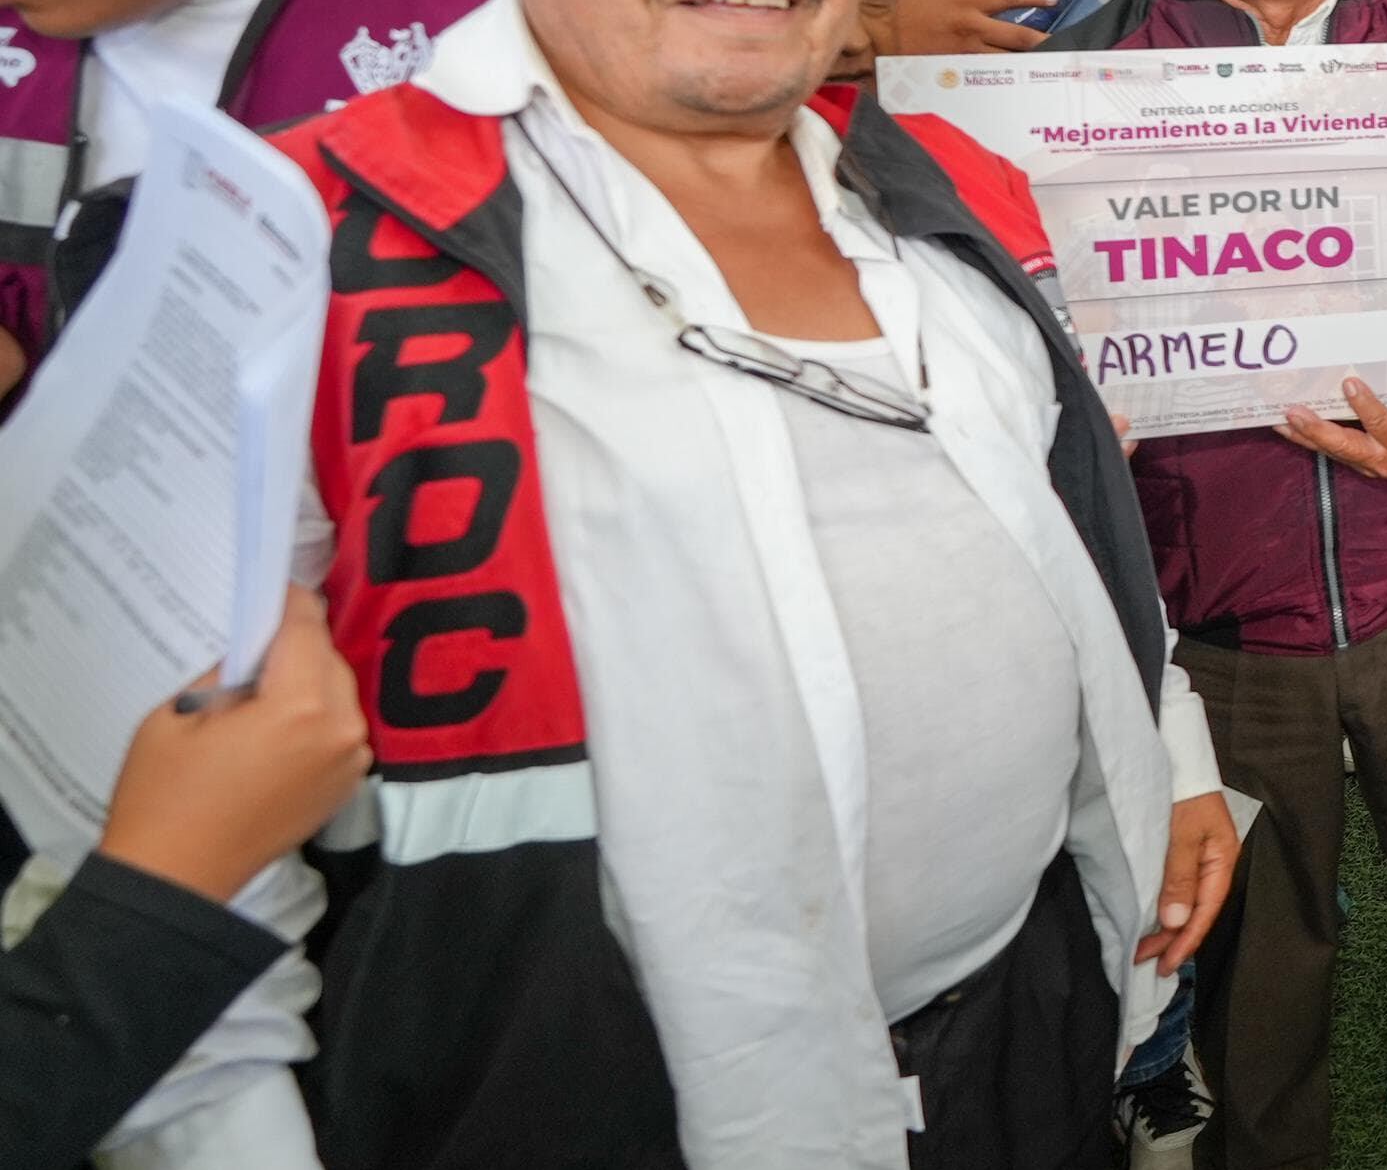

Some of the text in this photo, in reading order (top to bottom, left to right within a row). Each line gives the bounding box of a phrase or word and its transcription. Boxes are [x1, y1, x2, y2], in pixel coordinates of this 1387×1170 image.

[1176, 63, 1209, 72] PUEBLA
[1141, 102, 1299, 117] ENTREGA DE ACCIONES
[1031, 120, 1227, 146] “Mejoramiento
[1234, 123, 1247, 134] a
[1255, 118, 1275, 134] la
[1108, 186, 1339, 220] VALE POR UN
[1094, 227, 1353, 282] TINACO
[1099, 325, 1296, 385] ARMELO
